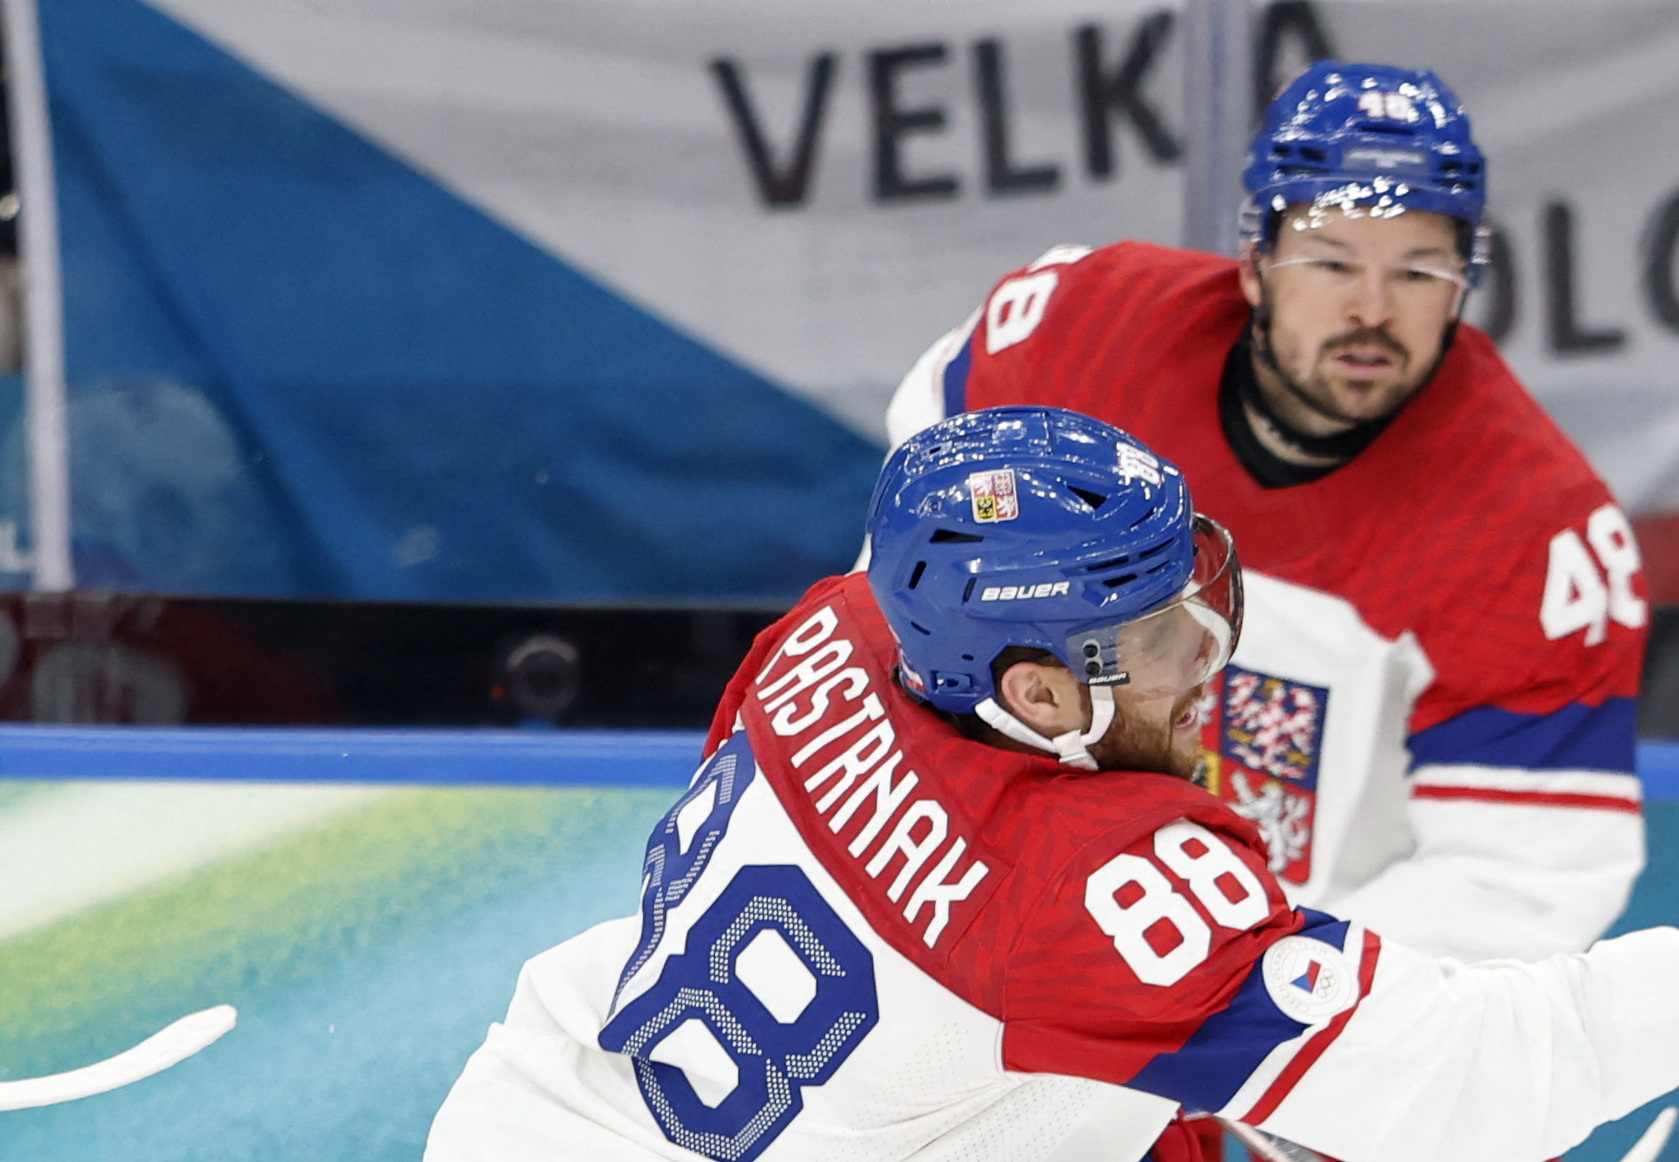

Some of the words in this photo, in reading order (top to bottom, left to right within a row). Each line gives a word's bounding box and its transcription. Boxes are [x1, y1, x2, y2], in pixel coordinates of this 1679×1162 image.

[981, 580, 1070, 601] BAUER
[1538, 502, 1649, 647] 48
[755, 605, 990, 949] PASTRNAK
[1084, 816, 1271, 987] 88
